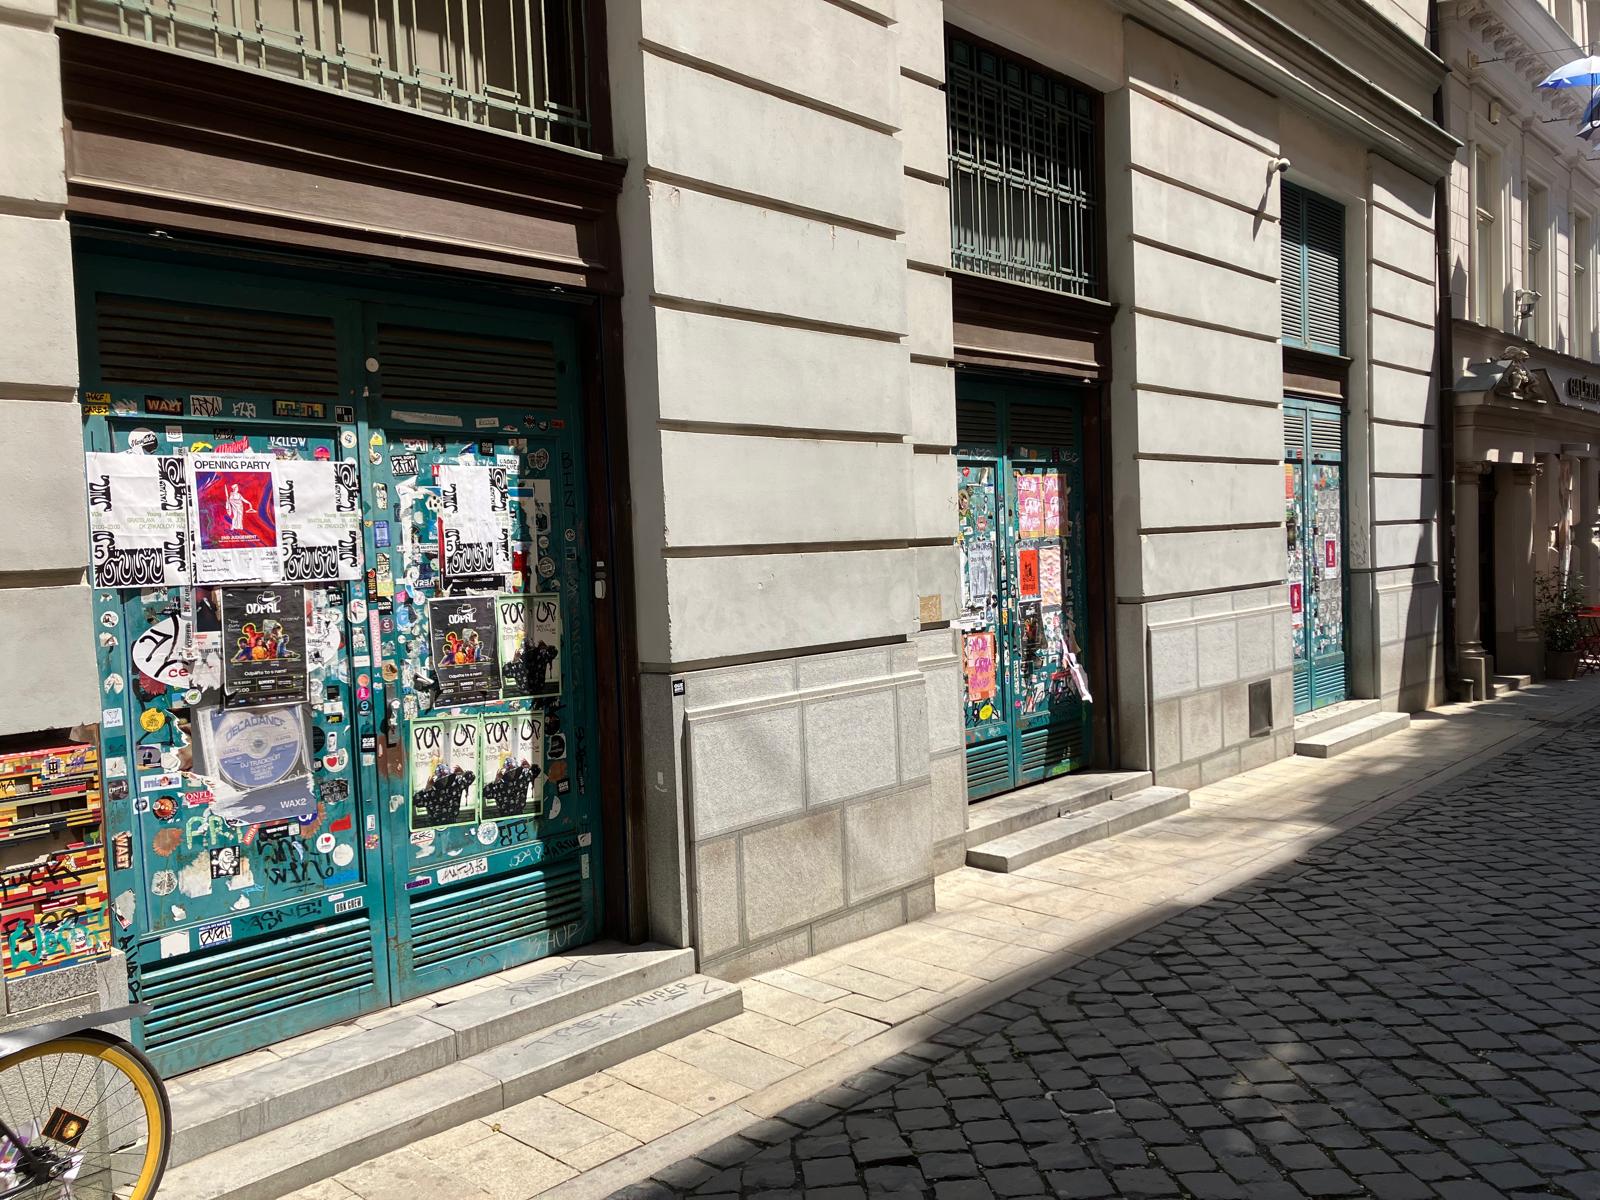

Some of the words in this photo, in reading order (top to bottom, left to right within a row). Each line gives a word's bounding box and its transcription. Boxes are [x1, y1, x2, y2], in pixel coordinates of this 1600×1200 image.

[194, 460, 239, 470] OPENING
[240, 460, 271, 470] PARTY
[94, 545, 105, 559] 5
[446, 541, 454, 552] 5
[501, 602, 526, 625] POP
[414, 725, 441, 751] POP
[485, 720, 510, 744] POP
[280, 797, 307, 809] WAX2
